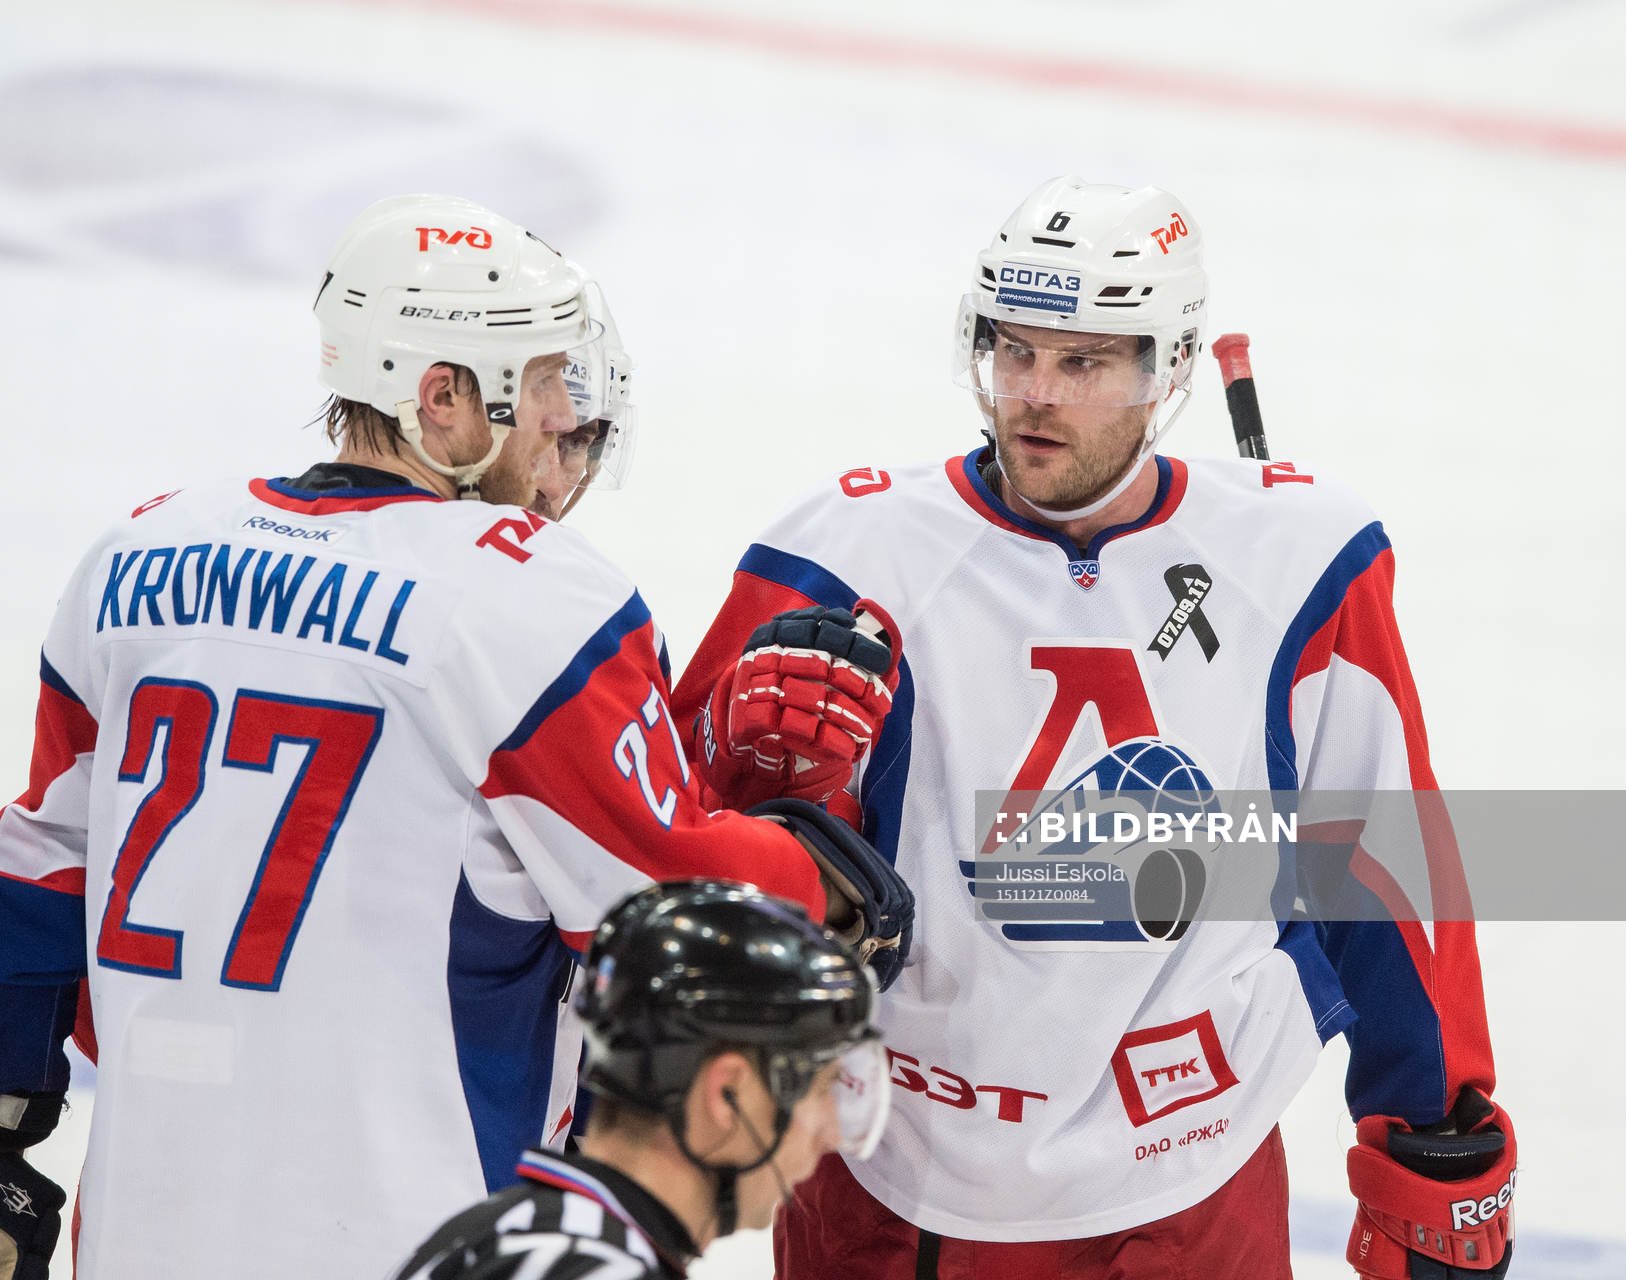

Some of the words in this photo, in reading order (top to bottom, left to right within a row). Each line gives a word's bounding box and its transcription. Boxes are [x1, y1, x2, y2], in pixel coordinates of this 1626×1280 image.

[1046, 211, 1071, 232] 6
[1000, 267, 1081, 291] СОГАЗ
[1001, 293, 1042, 304] СТРАХОВАЯ
[1043, 298, 1073, 307] ГРУППА
[242, 516, 337, 541] Reebok
[96, 544, 416, 666] KRONWALL
[1157, 578, 1210, 649] 07.09.11
[612, 682, 690, 831] 27
[97, 676, 386, 993] 27
[1135, 1137, 1171, 1161] ОАО
[1178, 1117, 1229, 1147] «РЖД»
